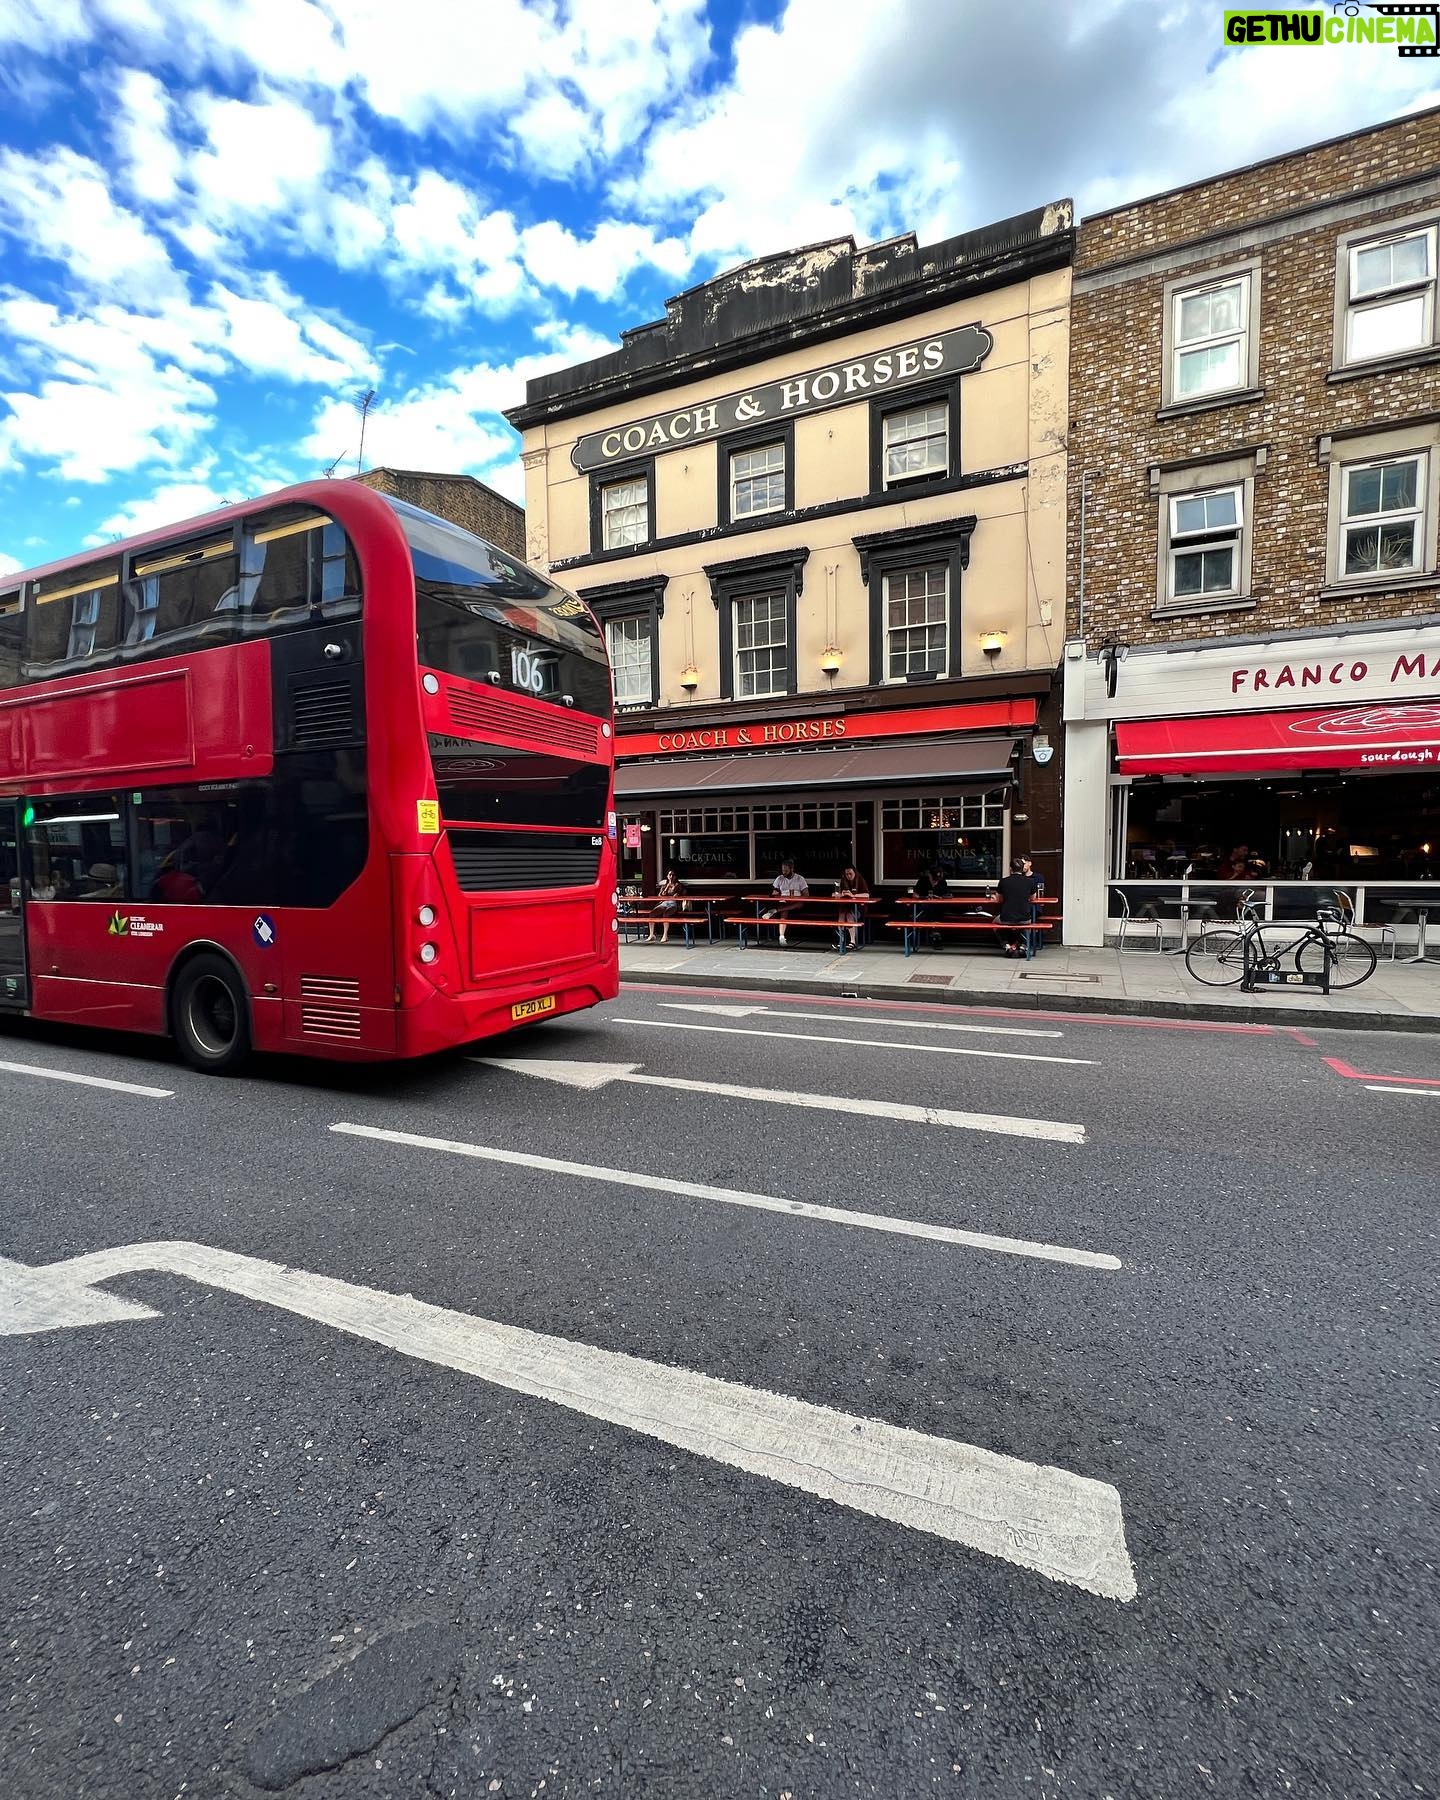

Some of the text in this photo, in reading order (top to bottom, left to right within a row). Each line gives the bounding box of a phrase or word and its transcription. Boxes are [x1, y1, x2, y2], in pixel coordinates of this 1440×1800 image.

[600, 340, 945, 458] COACH & HORSES
[511, 647, 544, 691] 106
[1232, 662, 1368, 693] FRANCO
[658, 719, 846, 750] COACH & HORSES
[1361, 749, 1433, 762] sourdough
[677, 852, 733, 862] COCKTAILS
[907, 847, 977, 860] FINE WINES
[515, 996, 552, 1017] LF20 XLJ
